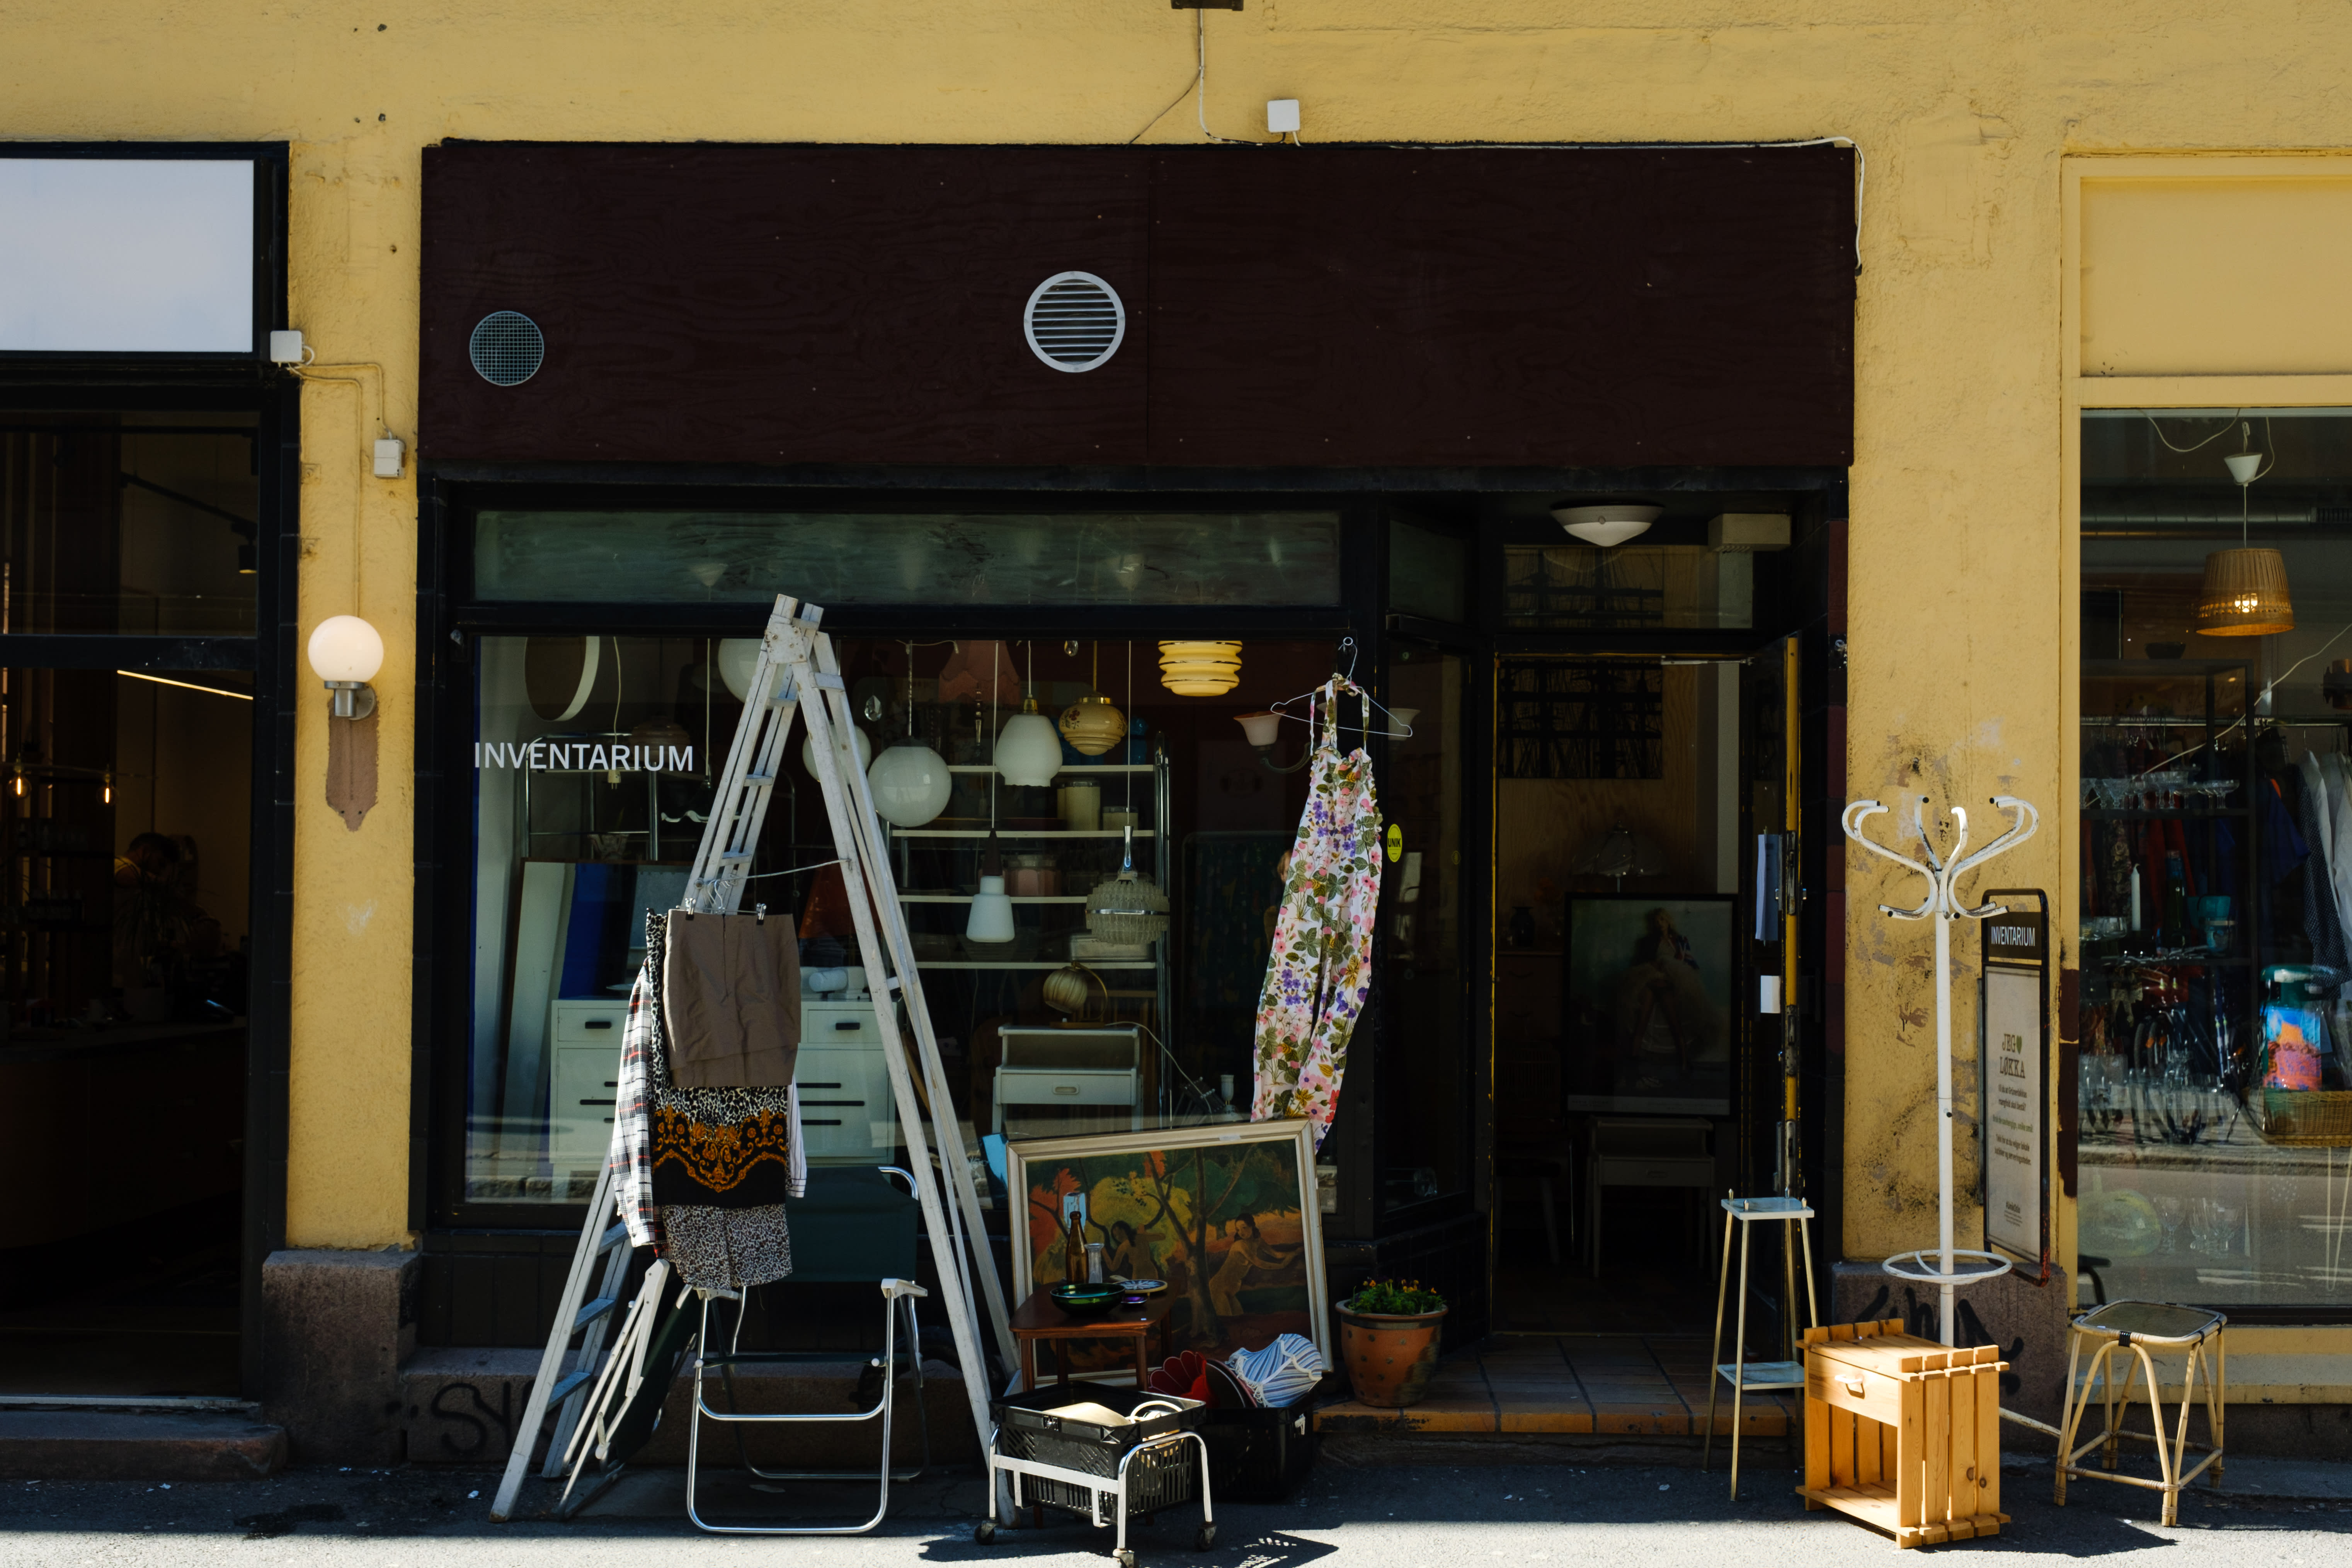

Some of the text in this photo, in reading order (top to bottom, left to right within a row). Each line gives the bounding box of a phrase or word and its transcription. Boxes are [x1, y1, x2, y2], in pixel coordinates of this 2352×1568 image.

[475, 742, 693, 771] INVENTARIUM
[1388, 838, 1401, 848] UNIK
[1991, 926, 2035, 946] INVENTARIUM
[2002, 1033, 2016, 1053] JEG
[2000, 1056, 2025, 1079] LØKKA
